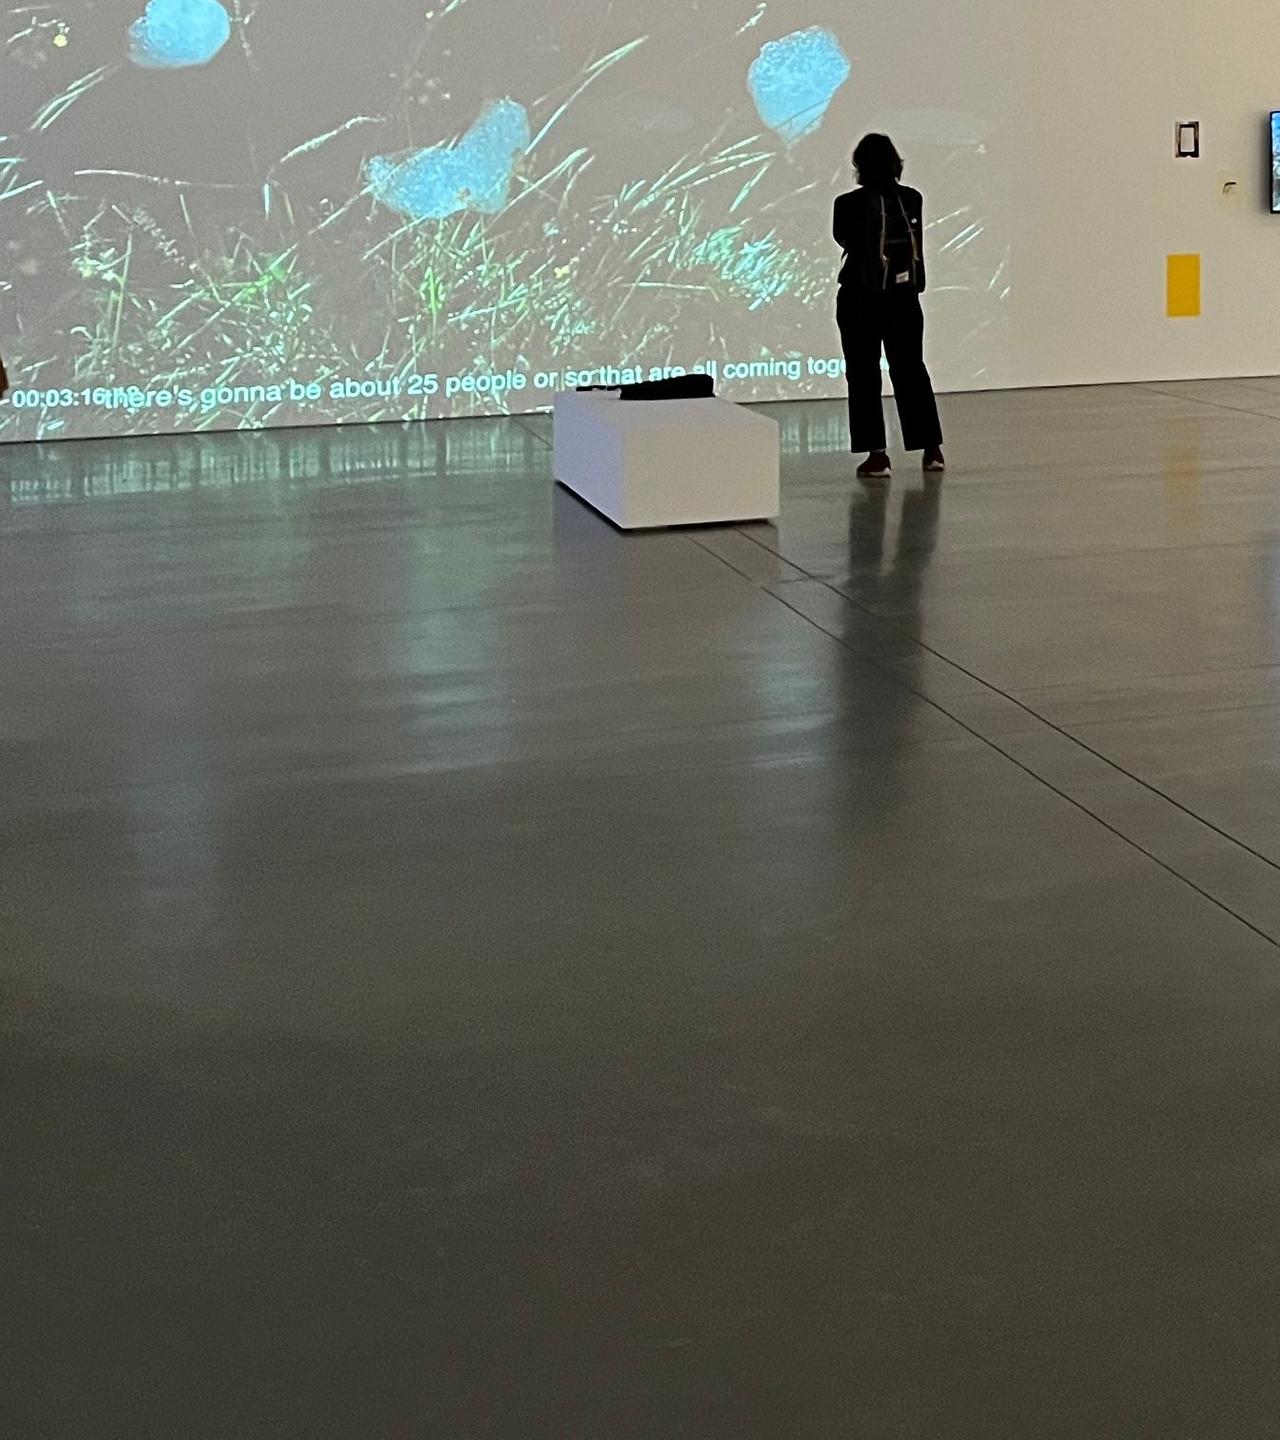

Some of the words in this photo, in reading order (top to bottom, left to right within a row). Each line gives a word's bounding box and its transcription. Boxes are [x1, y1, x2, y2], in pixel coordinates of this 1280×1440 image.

[201, 385, 282, 410] gonna
[290, 379, 321, 400] be
[330, 377, 400, 399] about
[408, 373, 439, 395] 25
[446, 370, 527, 397] people
[534, 371, 558, 388] or
[565, 371, 592, 386] so
[600, 364, 643, 385] that
[723, 358, 801, 380] coming
